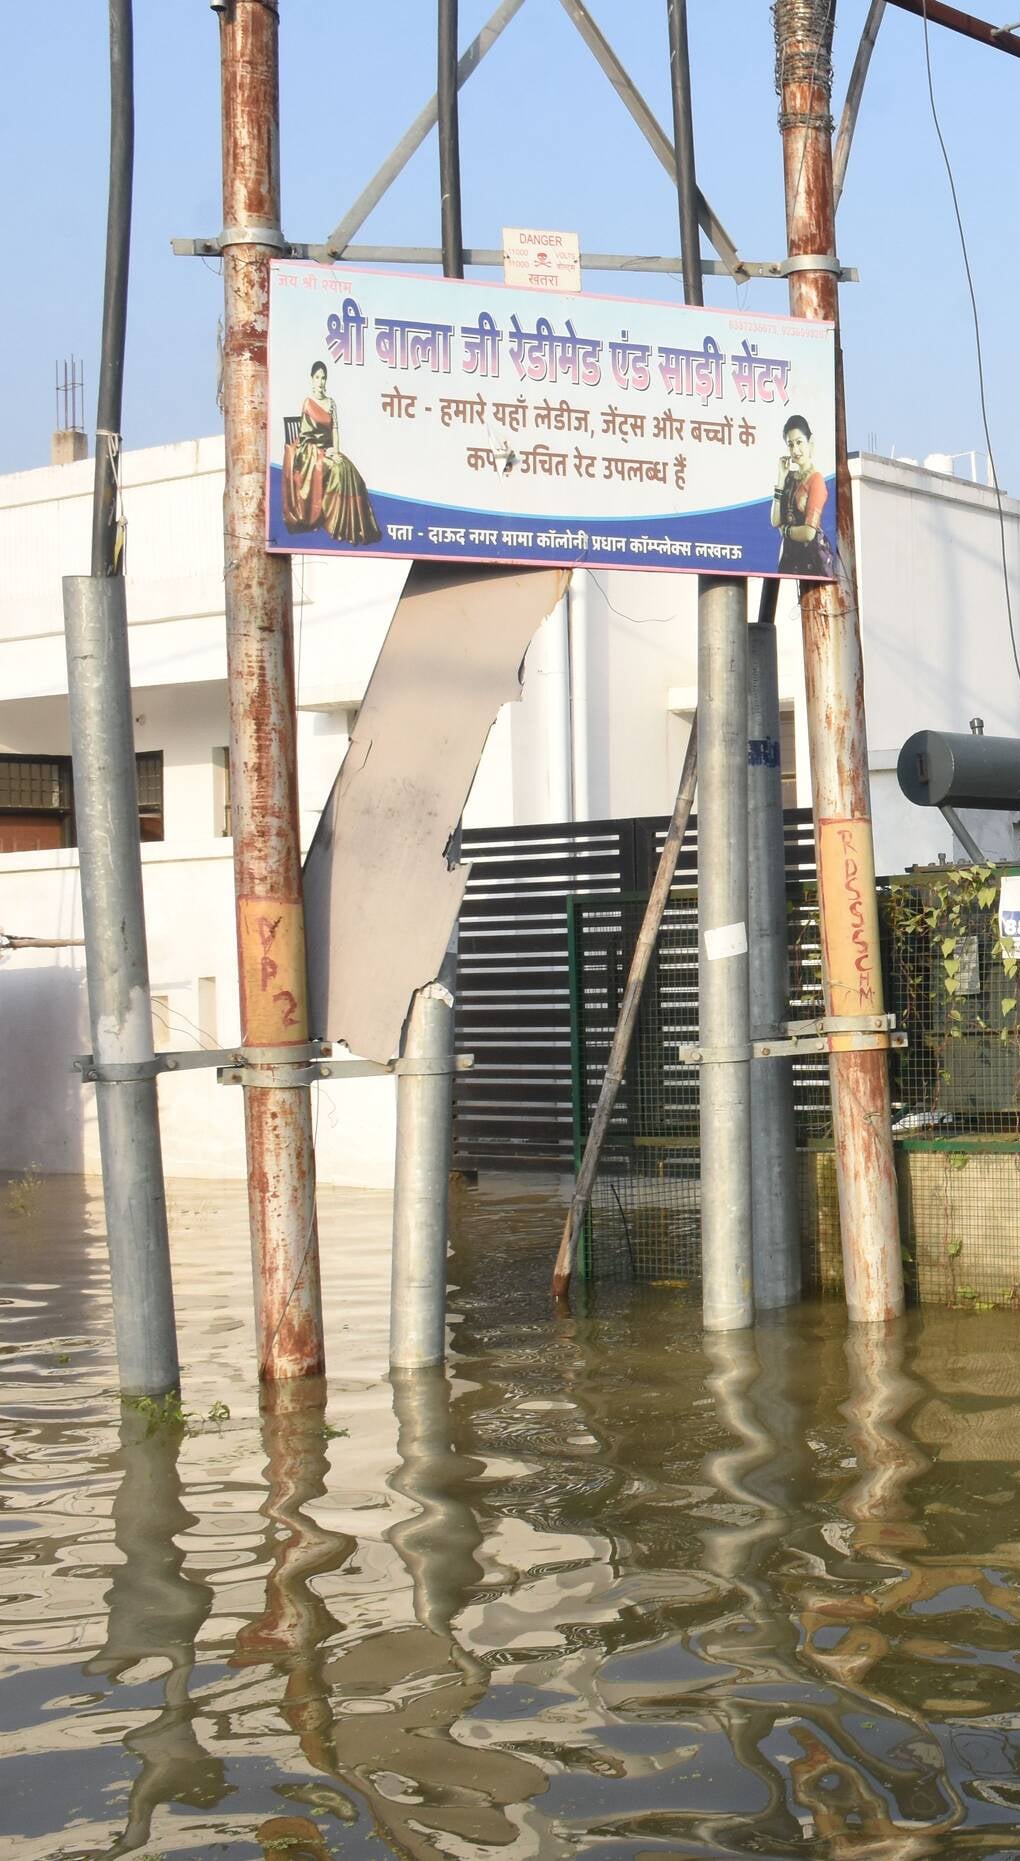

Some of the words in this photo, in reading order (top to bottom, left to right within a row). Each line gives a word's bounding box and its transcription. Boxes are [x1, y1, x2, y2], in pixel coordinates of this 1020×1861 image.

[519, 233, 563, 247] DANGER
[278, 274, 298, 287] जय
[302, 273, 318, 290] श्री
[321, 278, 353, 293] श्याम
[527, 273, 561, 287] खतरा
[325, 297, 368, 366] श्री
[374, 318, 455, 373] बाला
[461, 311, 503, 378] जी
[508, 314, 603, 386] रेडीमेड
[608, 329, 652, 391] एंड
[658, 335, 726, 406] साड़ी
[731, 339, 791, 406] सेंटर
[381, 385, 418, 418] नोट
[439, 392, 487, 427] हमारे
[492, 394, 528, 432] यहाँ
[533, 398, 595, 439] लेडीज,
[600, 404, 646, 443] जेंट्स
[652, 408, 686, 441] और
[690, 415, 734, 445] बच्चों
[738, 416, 757, 447] के
[520, 444, 568, 477] उचित
[573, 446, 597, 479] रेट
[602, 457, 668, 484] उपलब्ध
[674, 453, 687, 490] हैं
[387, 524, 414, 541] पता
[428, 526, 466, 545] दाऊद
[469, 529, 498, 546] नगर
[502, 531, 533, 548] मामा
[536, 529, 589, 550] कॉलोनी
[592, 535, 627, 553] प्रधान
[630, 535, 692, 557] कॉम्प्लेक्स
[695, 542, 743, 560] लखनऊ
